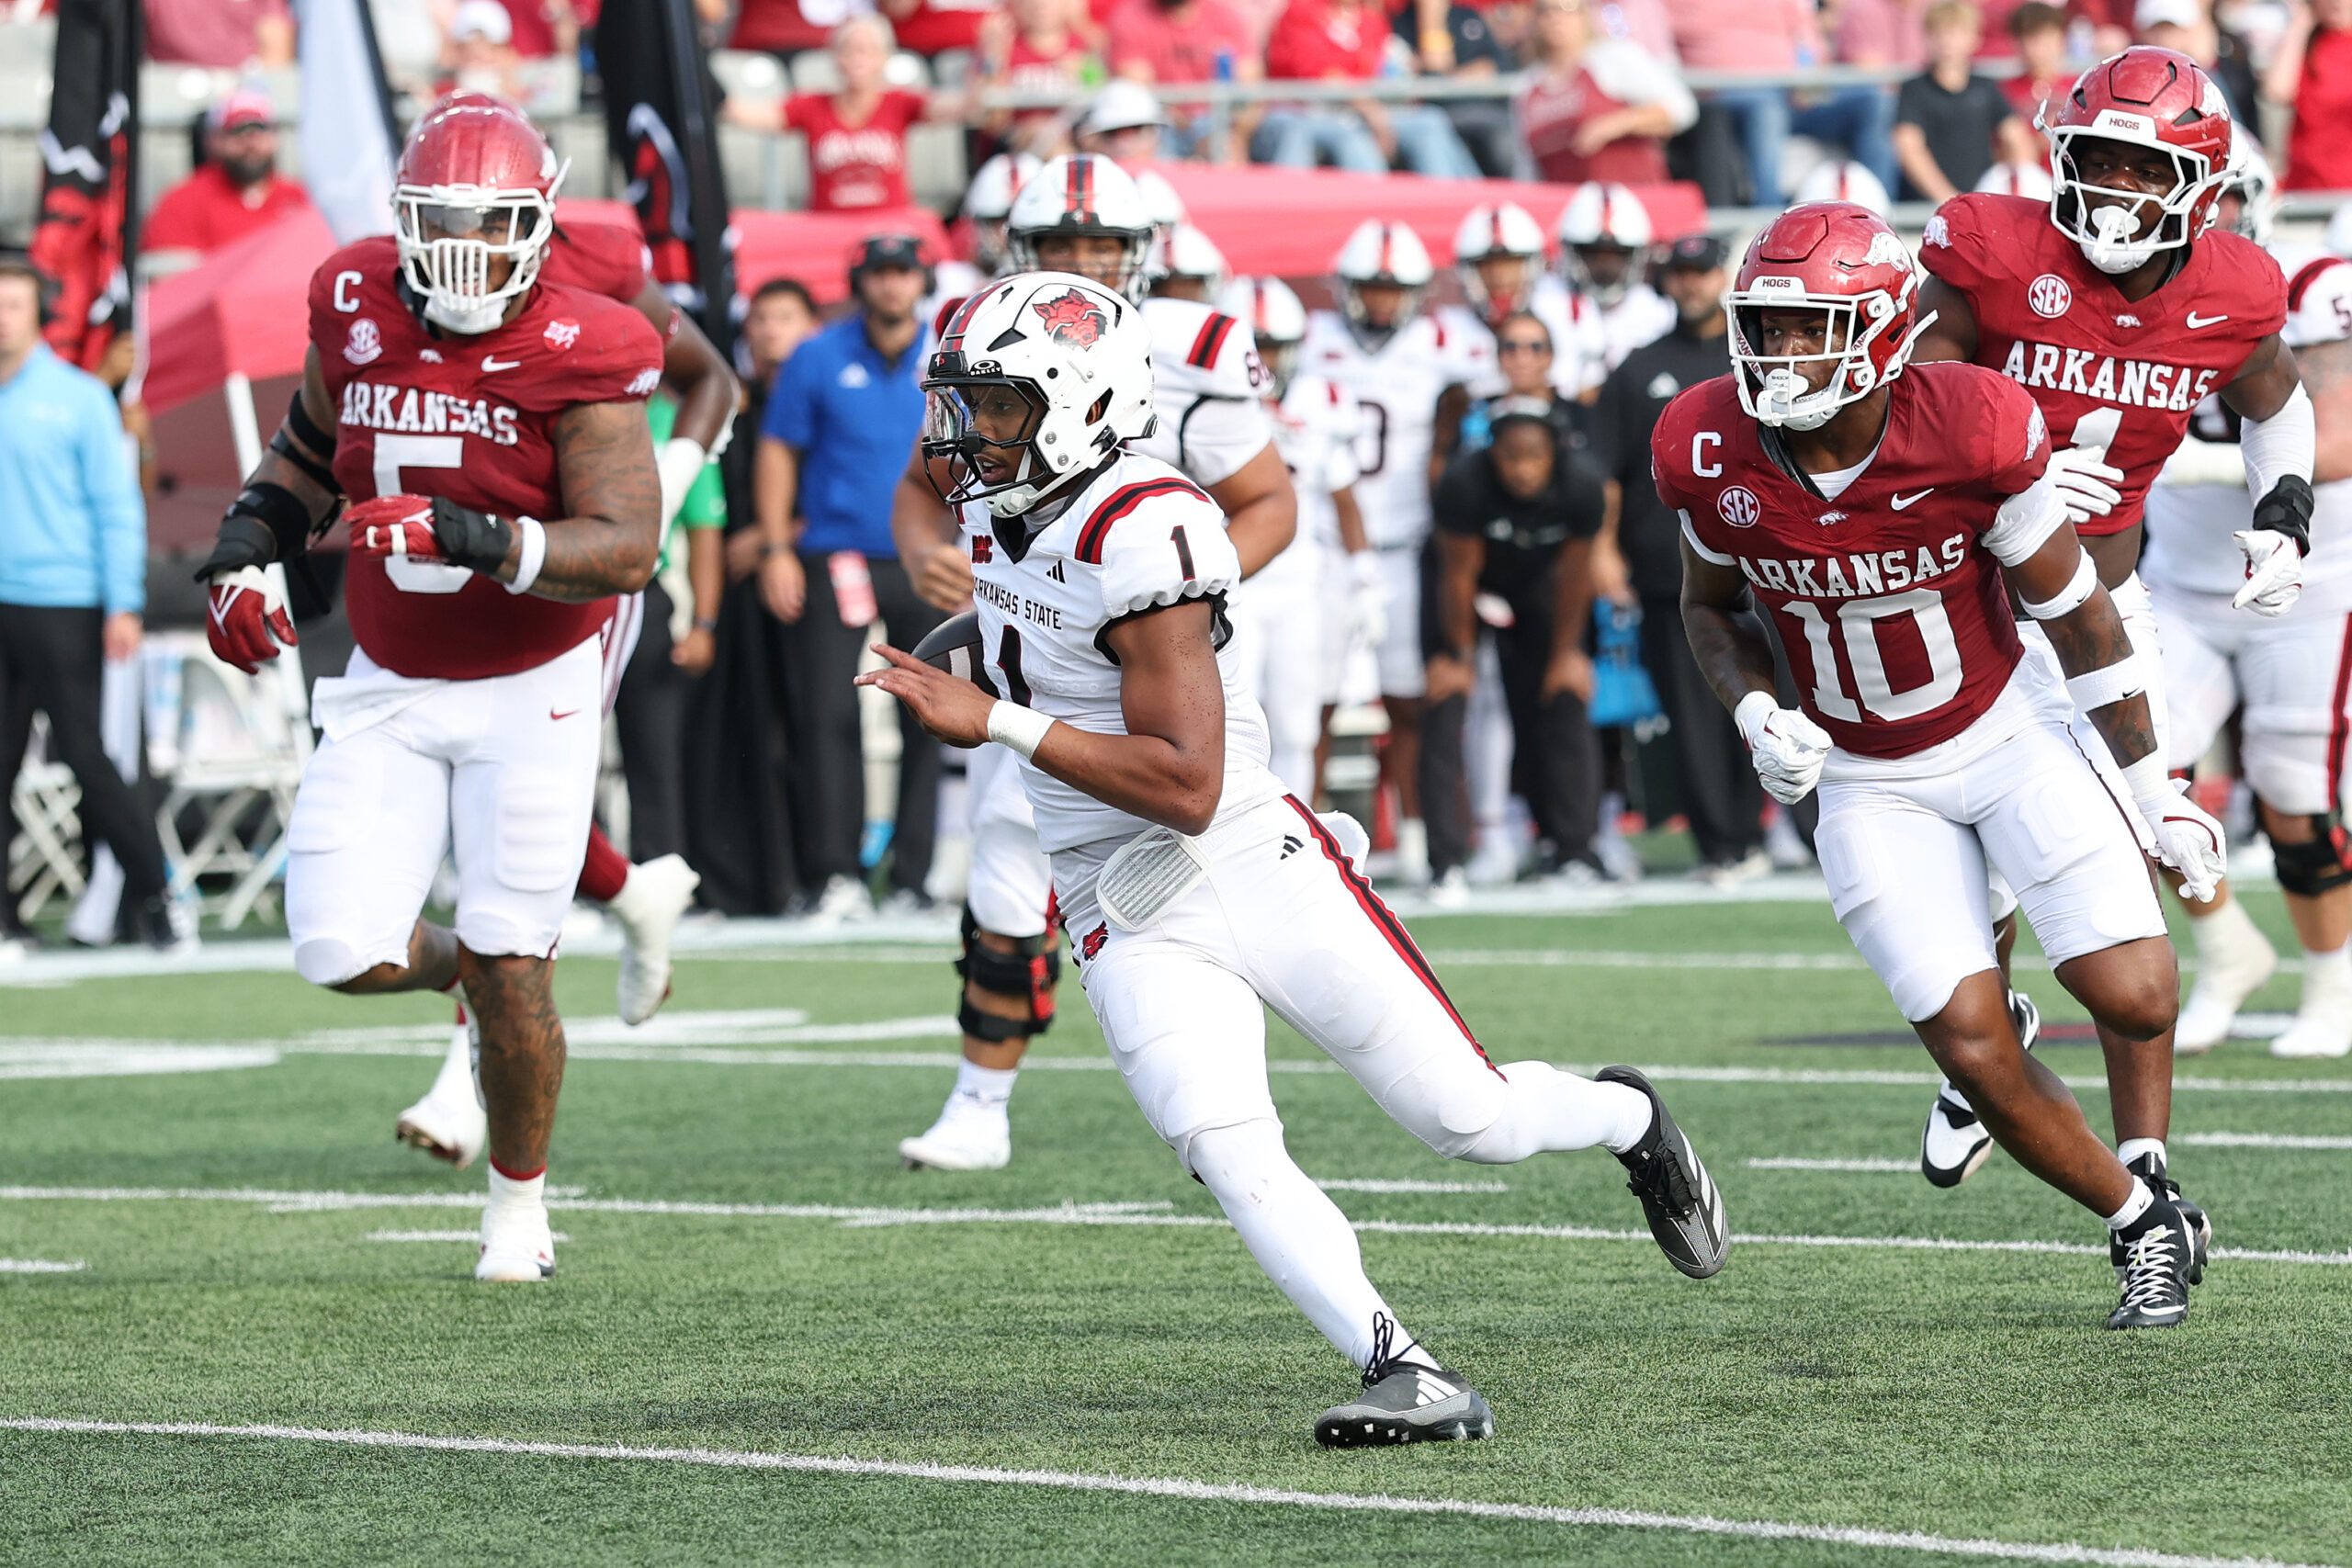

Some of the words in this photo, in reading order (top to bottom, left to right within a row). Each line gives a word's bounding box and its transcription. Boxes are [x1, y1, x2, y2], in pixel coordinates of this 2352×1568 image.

[2109, 118, 2141, 130] HOGS
[334, 271, 363, 312] C
[1761, 278, 1792, 288] HOGS
[2032, 276, 2068, 314] SEC
[970, 367, 1001, 377] OAKLEY
[2001, 340, 2219, 412] ARKANSAS
[340, 381, 518, 446] ARKANSAS
[2070, 406, 2124, 464] 1
[1692, 432, 1723, 478] C
[373, 433, 474, 593] 5
[1721, 489, 1756, 525] SEC
[1170, 525, 1196, 581] 1
[1738, 533, 1965, 598] ARKANSAS
[974, 576, 1019, 615] ARKANSAS
[1024, 599, 1062, 631] STATE
[997, 625, 1032, 709] 1
[1781, 587, 1964, 723] 10
